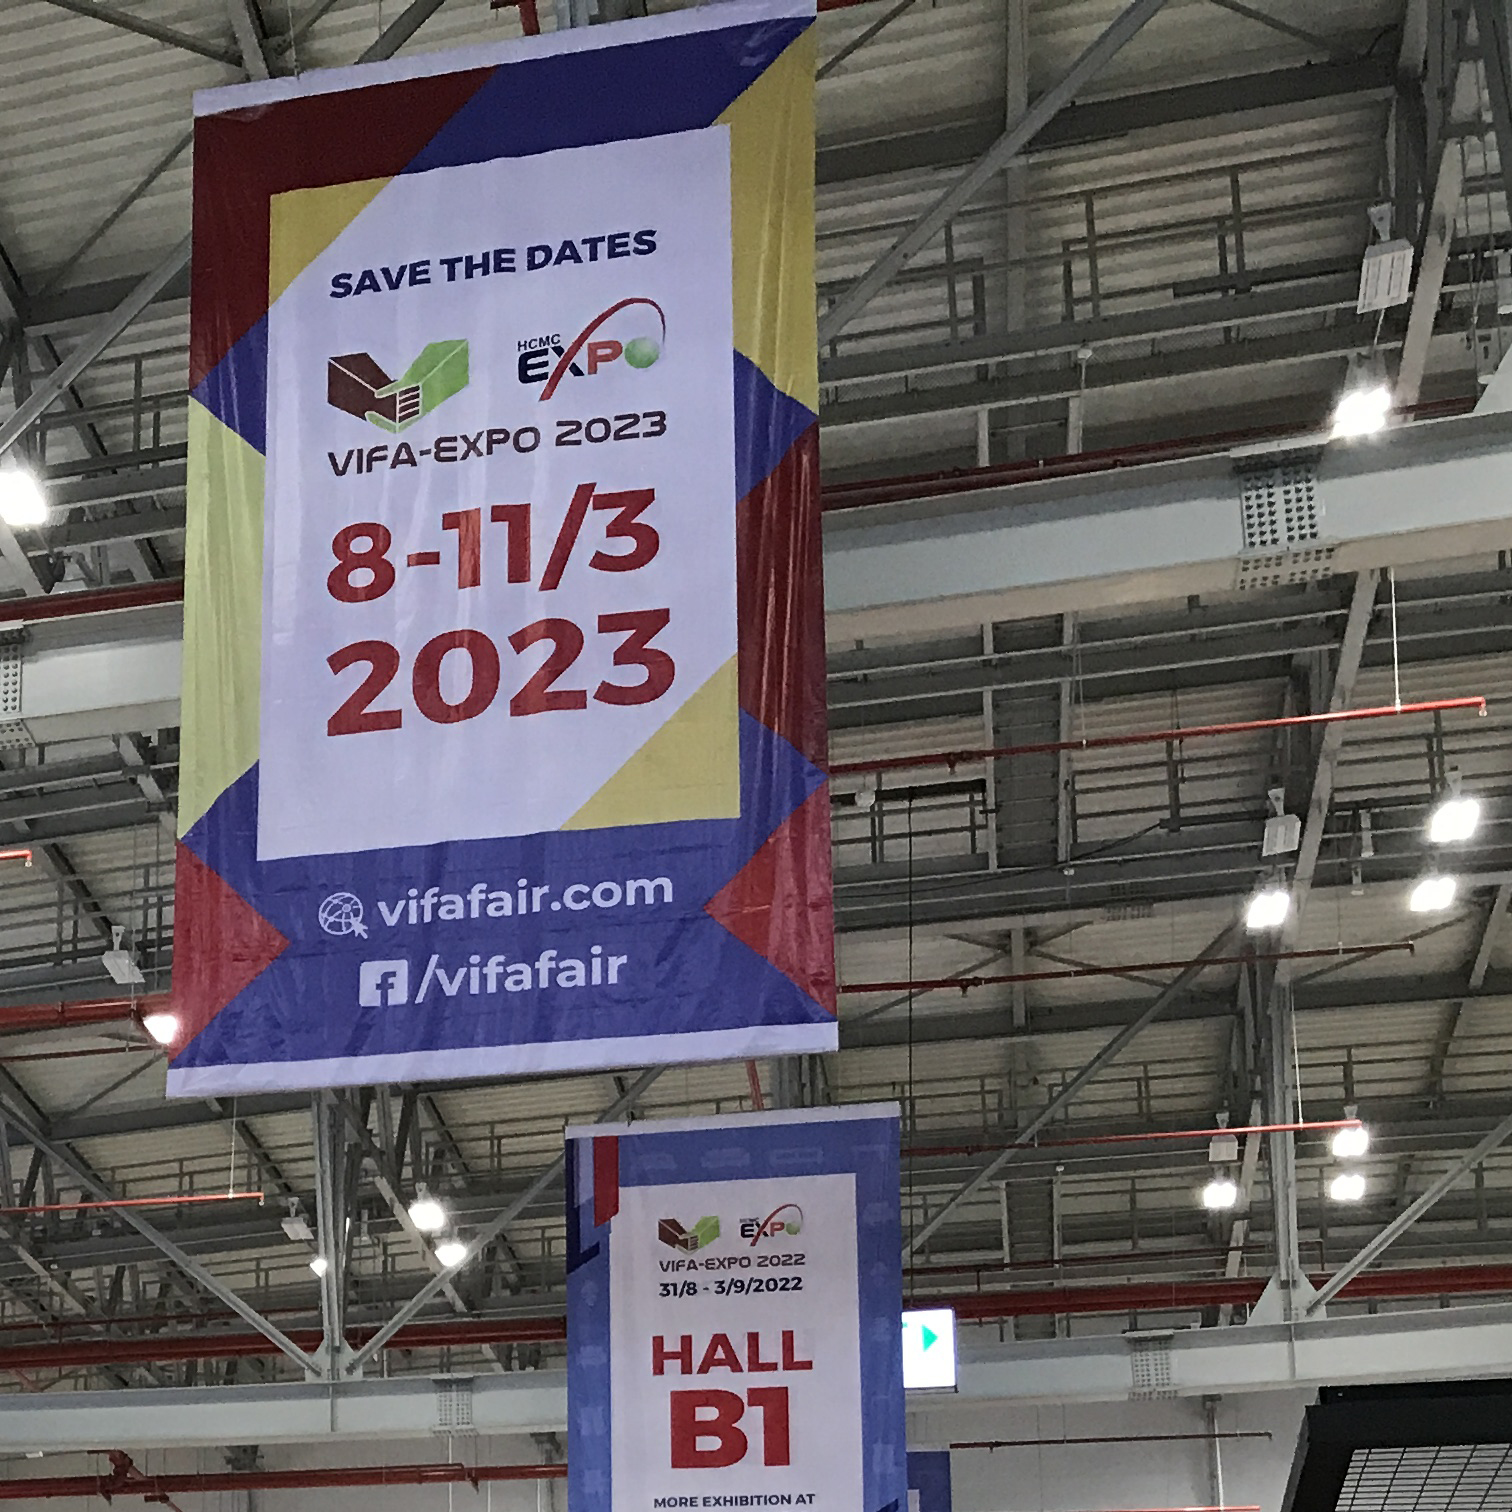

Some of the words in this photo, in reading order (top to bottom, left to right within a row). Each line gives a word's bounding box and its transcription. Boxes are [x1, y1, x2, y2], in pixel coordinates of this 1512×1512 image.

[329, 259, 432, 299] SAVE
[439, 247, 517, 284] THE
[526, 229, 659, 271] DATES
[517, 333, 561, 351] HCMC
[328, 426, 541, 477] VIFA-EXPO
[555, 410, 668, 448] 2023
[326, 482, 660, 603] 8-11/3
[326, 607, 676, 737] 2023
[378, 874, 674, 927] vifafair.com
[658, 1256, 752, 1273] VIFA-EXPO
[756, 1253, 806, 1268] 2022
[658, 1280, 698, 1298] 31/8
[713, 1276, 803, 1297] 3/9/2022
[651, 1329, 814, 1376] HALL
[669, 1386, 791, 1470] B1
[653, 1497, 700, 1509] MORE
[702, 1494, 795, 1508] EXHIBITION
[797, 1493, 816, 1506] AT
